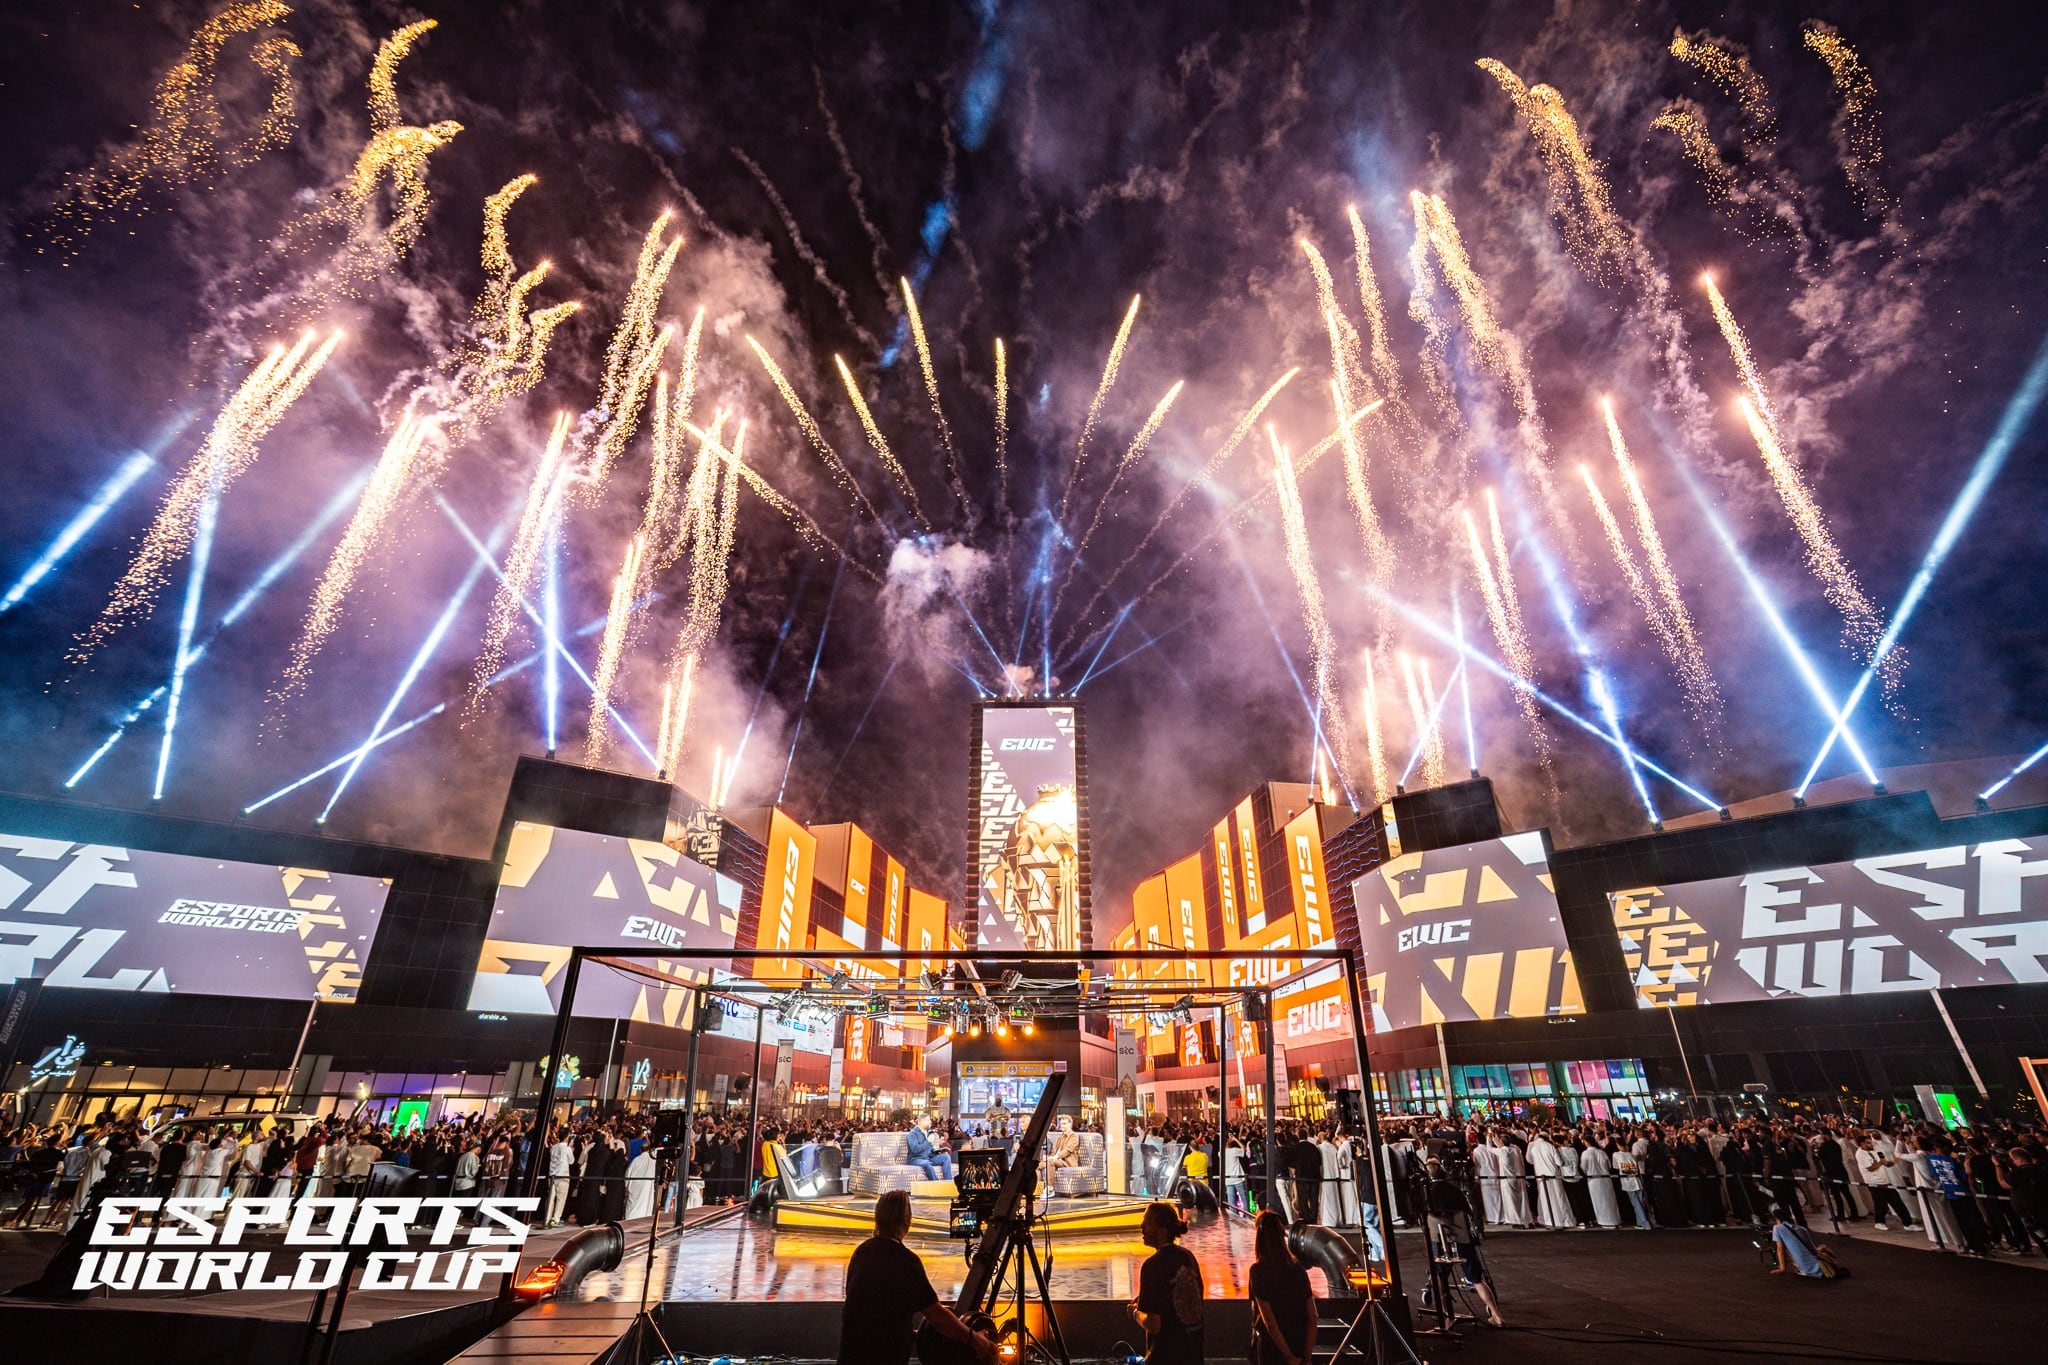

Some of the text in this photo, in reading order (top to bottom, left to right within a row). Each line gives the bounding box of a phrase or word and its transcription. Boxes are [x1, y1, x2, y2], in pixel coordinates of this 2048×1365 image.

[1000, 738, 1056, 750] EWC
[1241, 828, 1258, 903] EWC
[1219, 841, 1235, 925] EWC
[157, 911, 299, 933] WORLD CUP
[167, 899, 309, 924] ESPORTS
[621, 916, 686, 948] EWC
[1398, 919, 1472, 952] EWC
[1229, 934, 1291, 990] EWC
[1287, 995, 1342, 1037] EWC
[1119, 1046, 1135, 1055] stc
